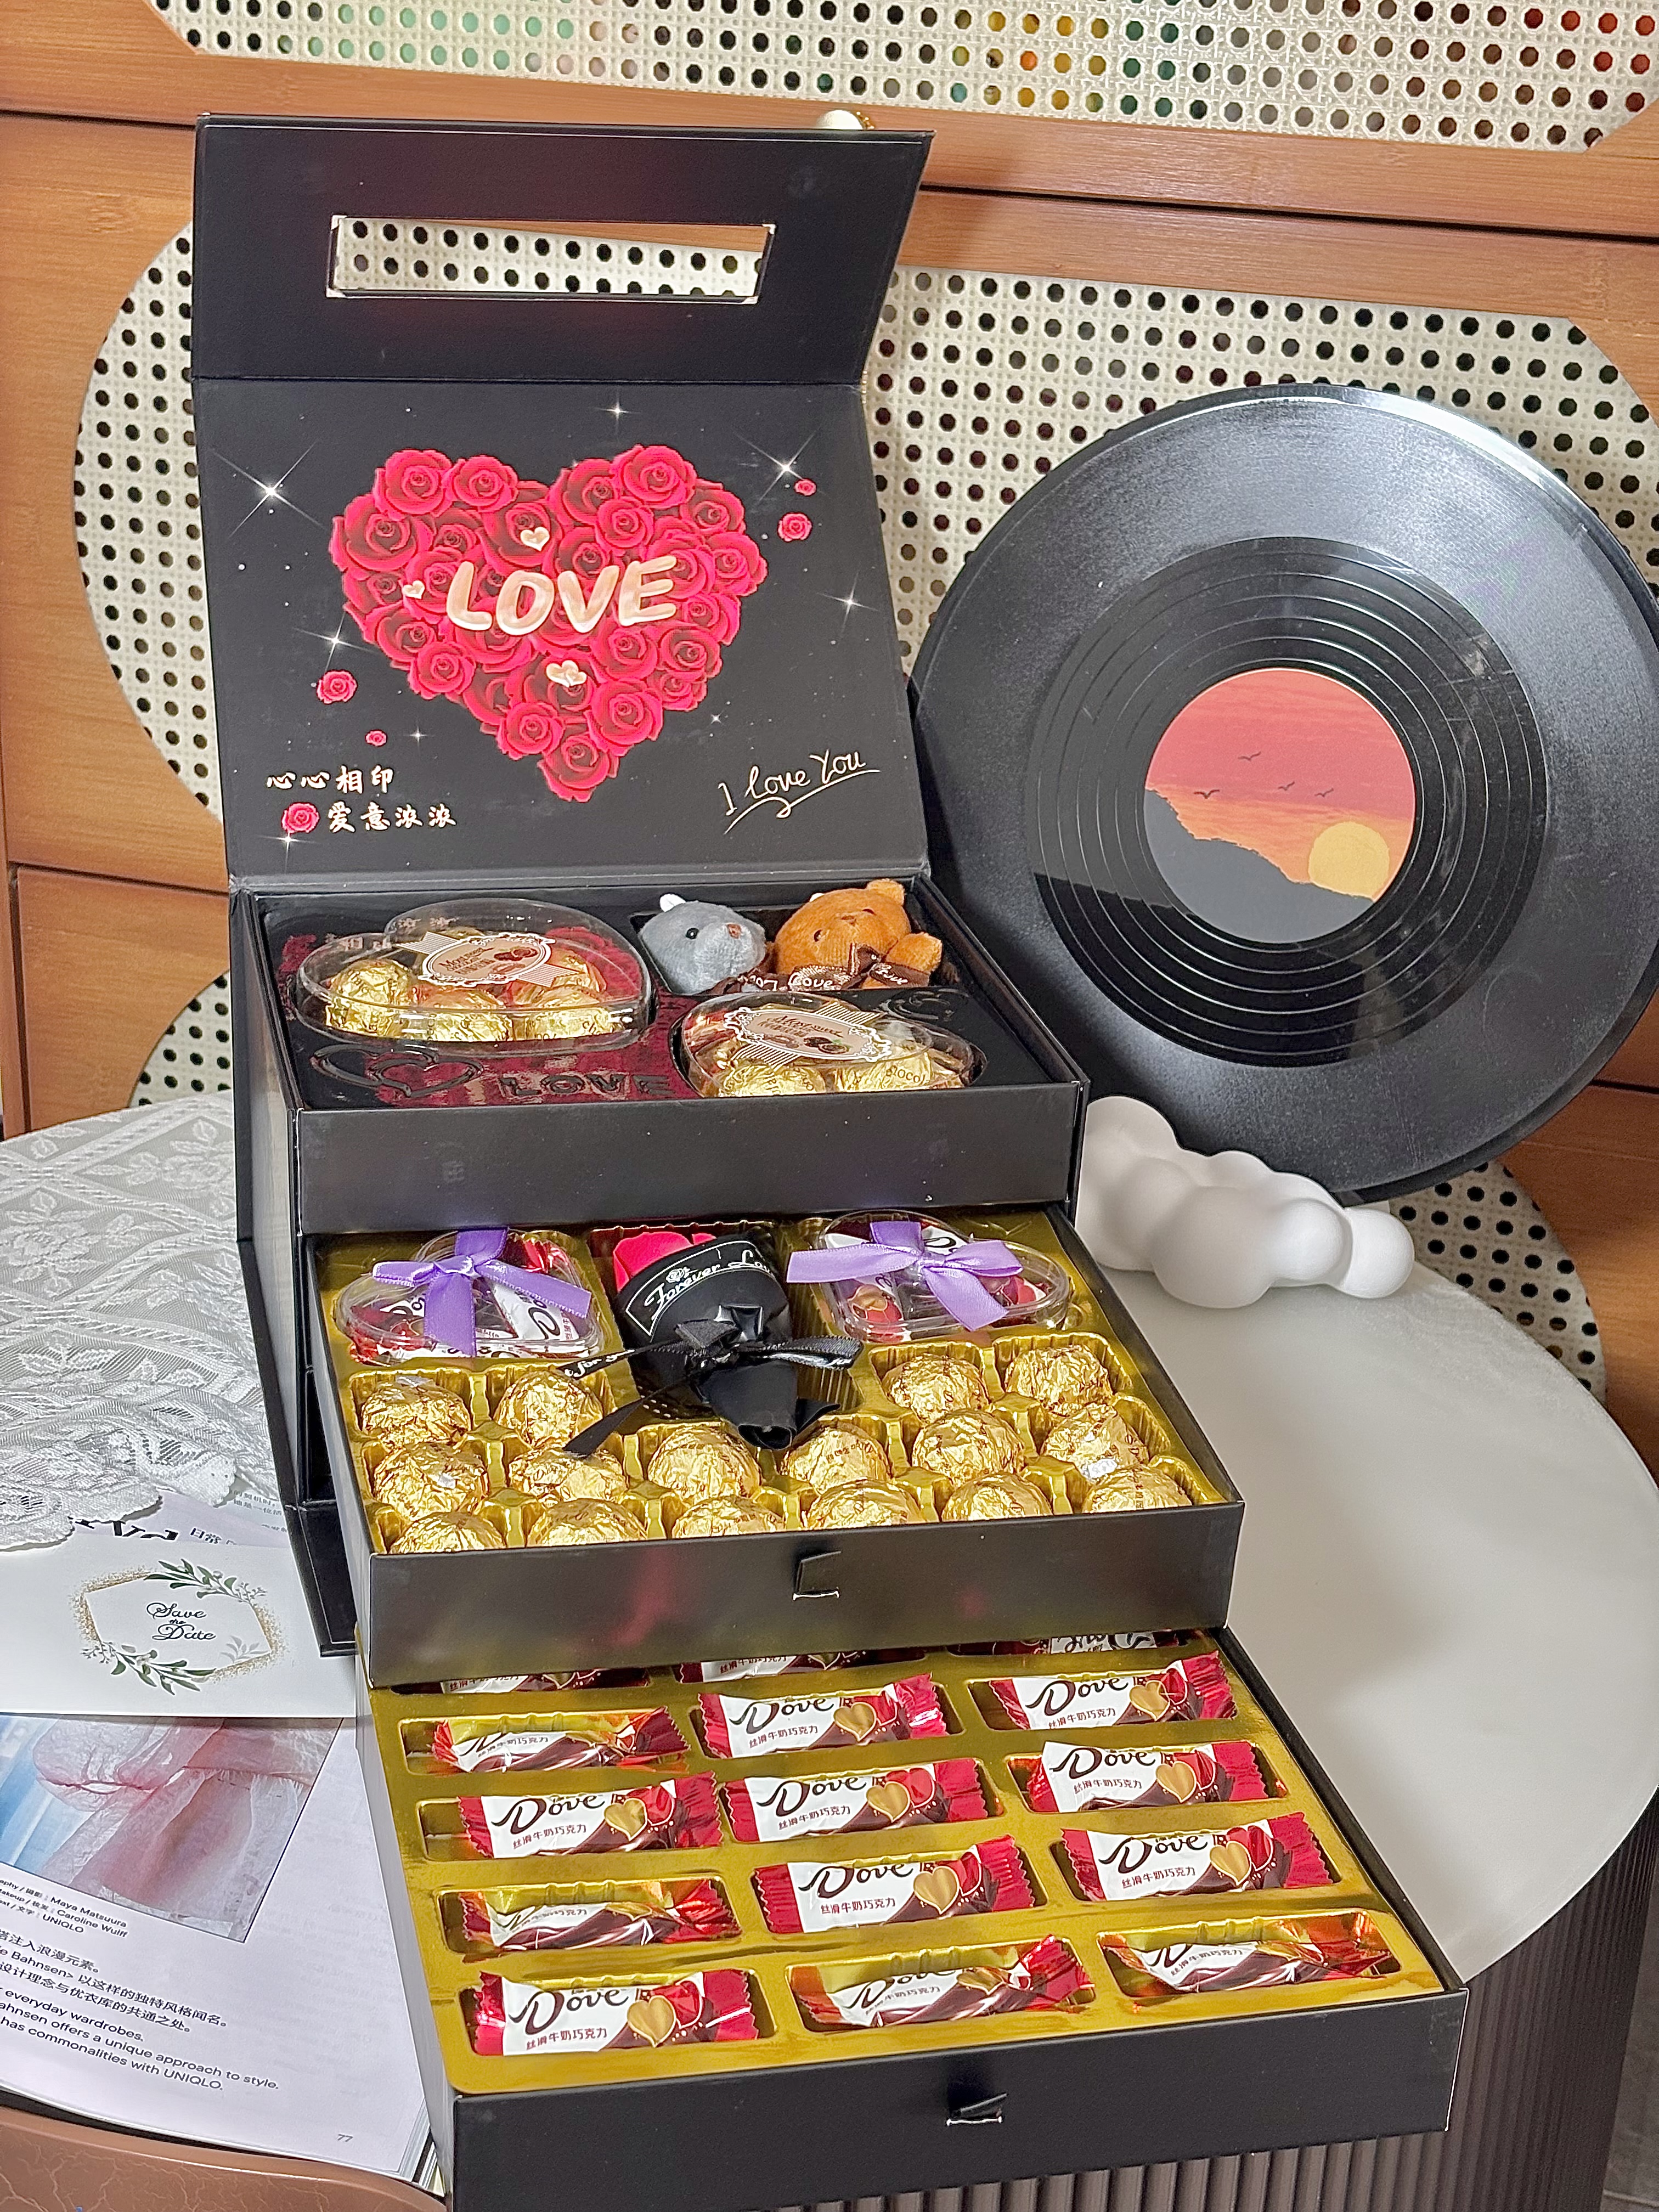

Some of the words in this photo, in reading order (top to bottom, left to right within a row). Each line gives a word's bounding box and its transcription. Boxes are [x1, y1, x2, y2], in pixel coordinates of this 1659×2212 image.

[446, 555, 677, 635] LOVE
[266, 765, 394, 794] 心心相印
[328, 800, 456, 833] 爱意浓浓
[499, 1074, 675, 1097] LOVE
[644, 1263, 721, 1321] Forever
[146, 1602, 207, 1620] Save
[151, 1623, 217, 1641] Date
[1025, 1677, 1129, 1717] Dove
[729, 1696, 834, 1735] Dove
[1052, 1747, 1156, 1779] Dove
[757, 1776, 868, 1817] Dove
[491, 1795, 605, 1835] Dove
[513, 1824, 587, 1849] 丝滑牛奶巧克力
[1098, 1834, 1209, 1874] Dove
[798, 1863, 914, 1899] Dove
[1121, 1866, 1197, 1889] 丝滑牛奶巧克力
[0, 1889, 25, 1902] akeup
[57, 1909, 99, 1928] Caroline
[101, 1924, 128, 1938] Wulff
[43, 1914, 84, 1933] UNIQLO
[50, 1897, 78, 1911] Maya
[80, 1907, 127, 1928] Matsuura
[820, 1897, 896, 1915] 丝滑牛奶巧克力
[11, 1951, 74, 1978] Bahnsen>
[78, 1974, 227, 2027] 以这样的独特风格闻名。
[5, 1990, 68, 2017] everyday
[71, 2012, 144, 2042] wardrobes.
[508, 1988, 629, 2035] Dove
[1, 2016, 25, 2031] has
[28, 2028, 128, 2066] commonalities
[131, 2059, 160, 2075] with
[163, 2068, 223, 2091] UNIQLO.
[51, 2021, 91, 2039] offers
[93, 2034, 101, 2042] a
[105, 2038, 153, 2058] unique
[156, 2053, 222, 2077] approach
[226, 2070, 240, 2080] to
[243, 2075, 279, 2090] style.
[526, 2028, 608, 2051] 丝滑牛奶巧克力
[337, 2134, 354, 2142] 77
